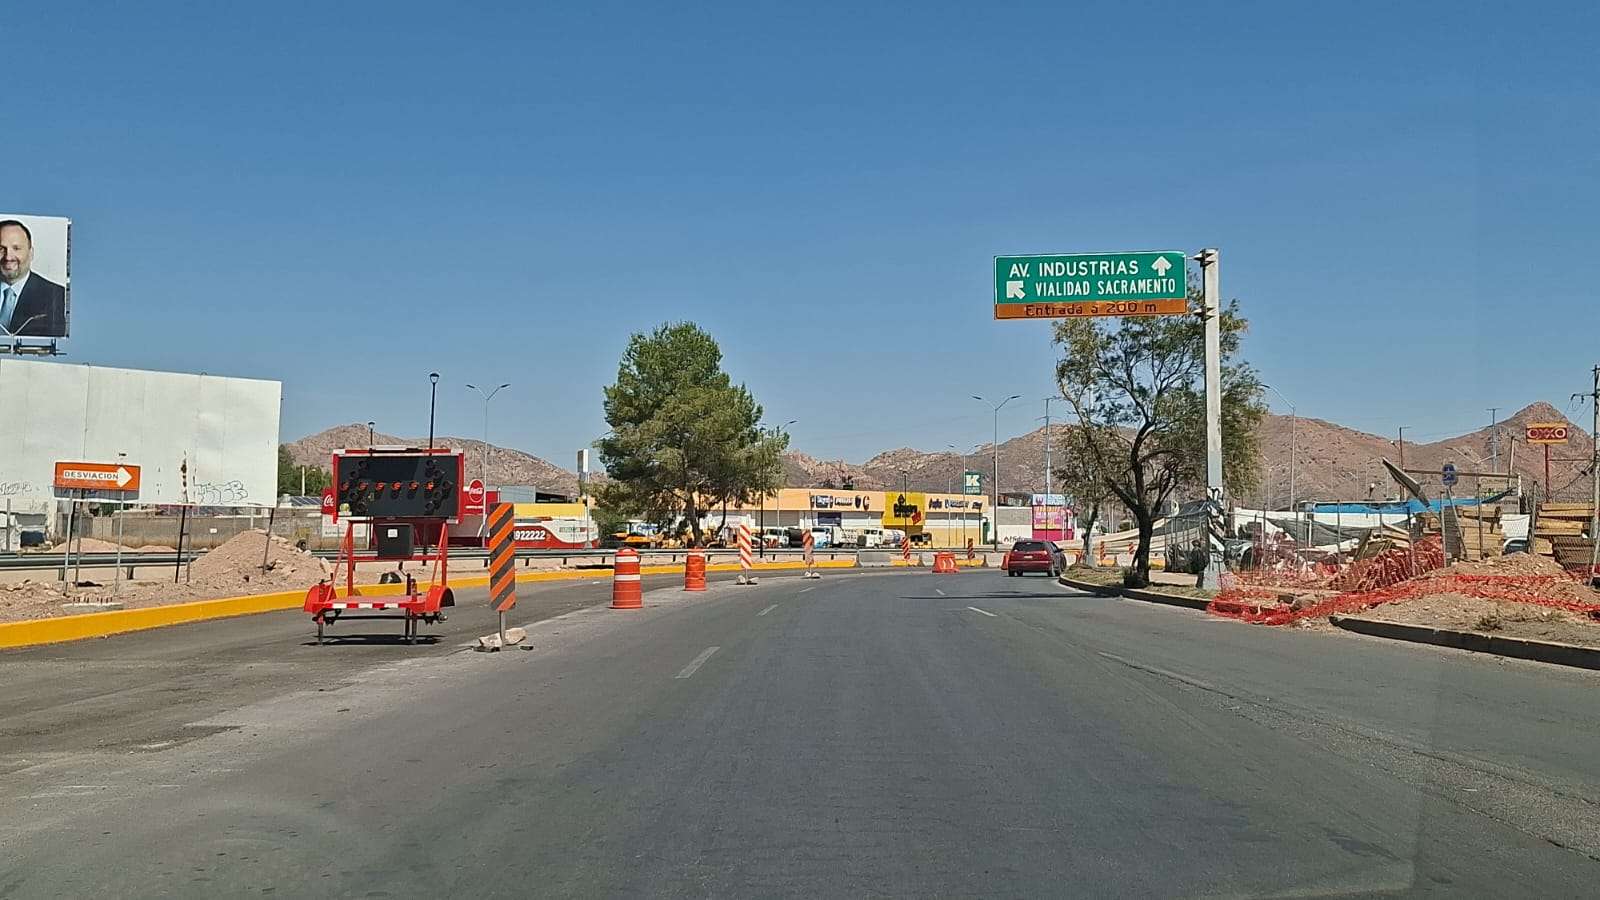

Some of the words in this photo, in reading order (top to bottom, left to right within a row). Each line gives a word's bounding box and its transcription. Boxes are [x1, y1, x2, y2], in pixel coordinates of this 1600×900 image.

[1009, 263, 1029, 278] AV.
[1039, 260, 1139, 277] INDUSTRIAS
[1035, 281, 1090, 297] VIALIDAD
[1097, 278, 1176, 295] SACRAMENTO
[1025, 304, 1083, 316] Entrada
[1091, 305, 1099, 314] a
[1106, 302, 1137, 313] 200
[1145, 303, 1157, 313] m
[1527, 428, 1566, 439] OXXO
[64, 471, 119, 480] DESVIACION
[965, 474, 981, 487] K
